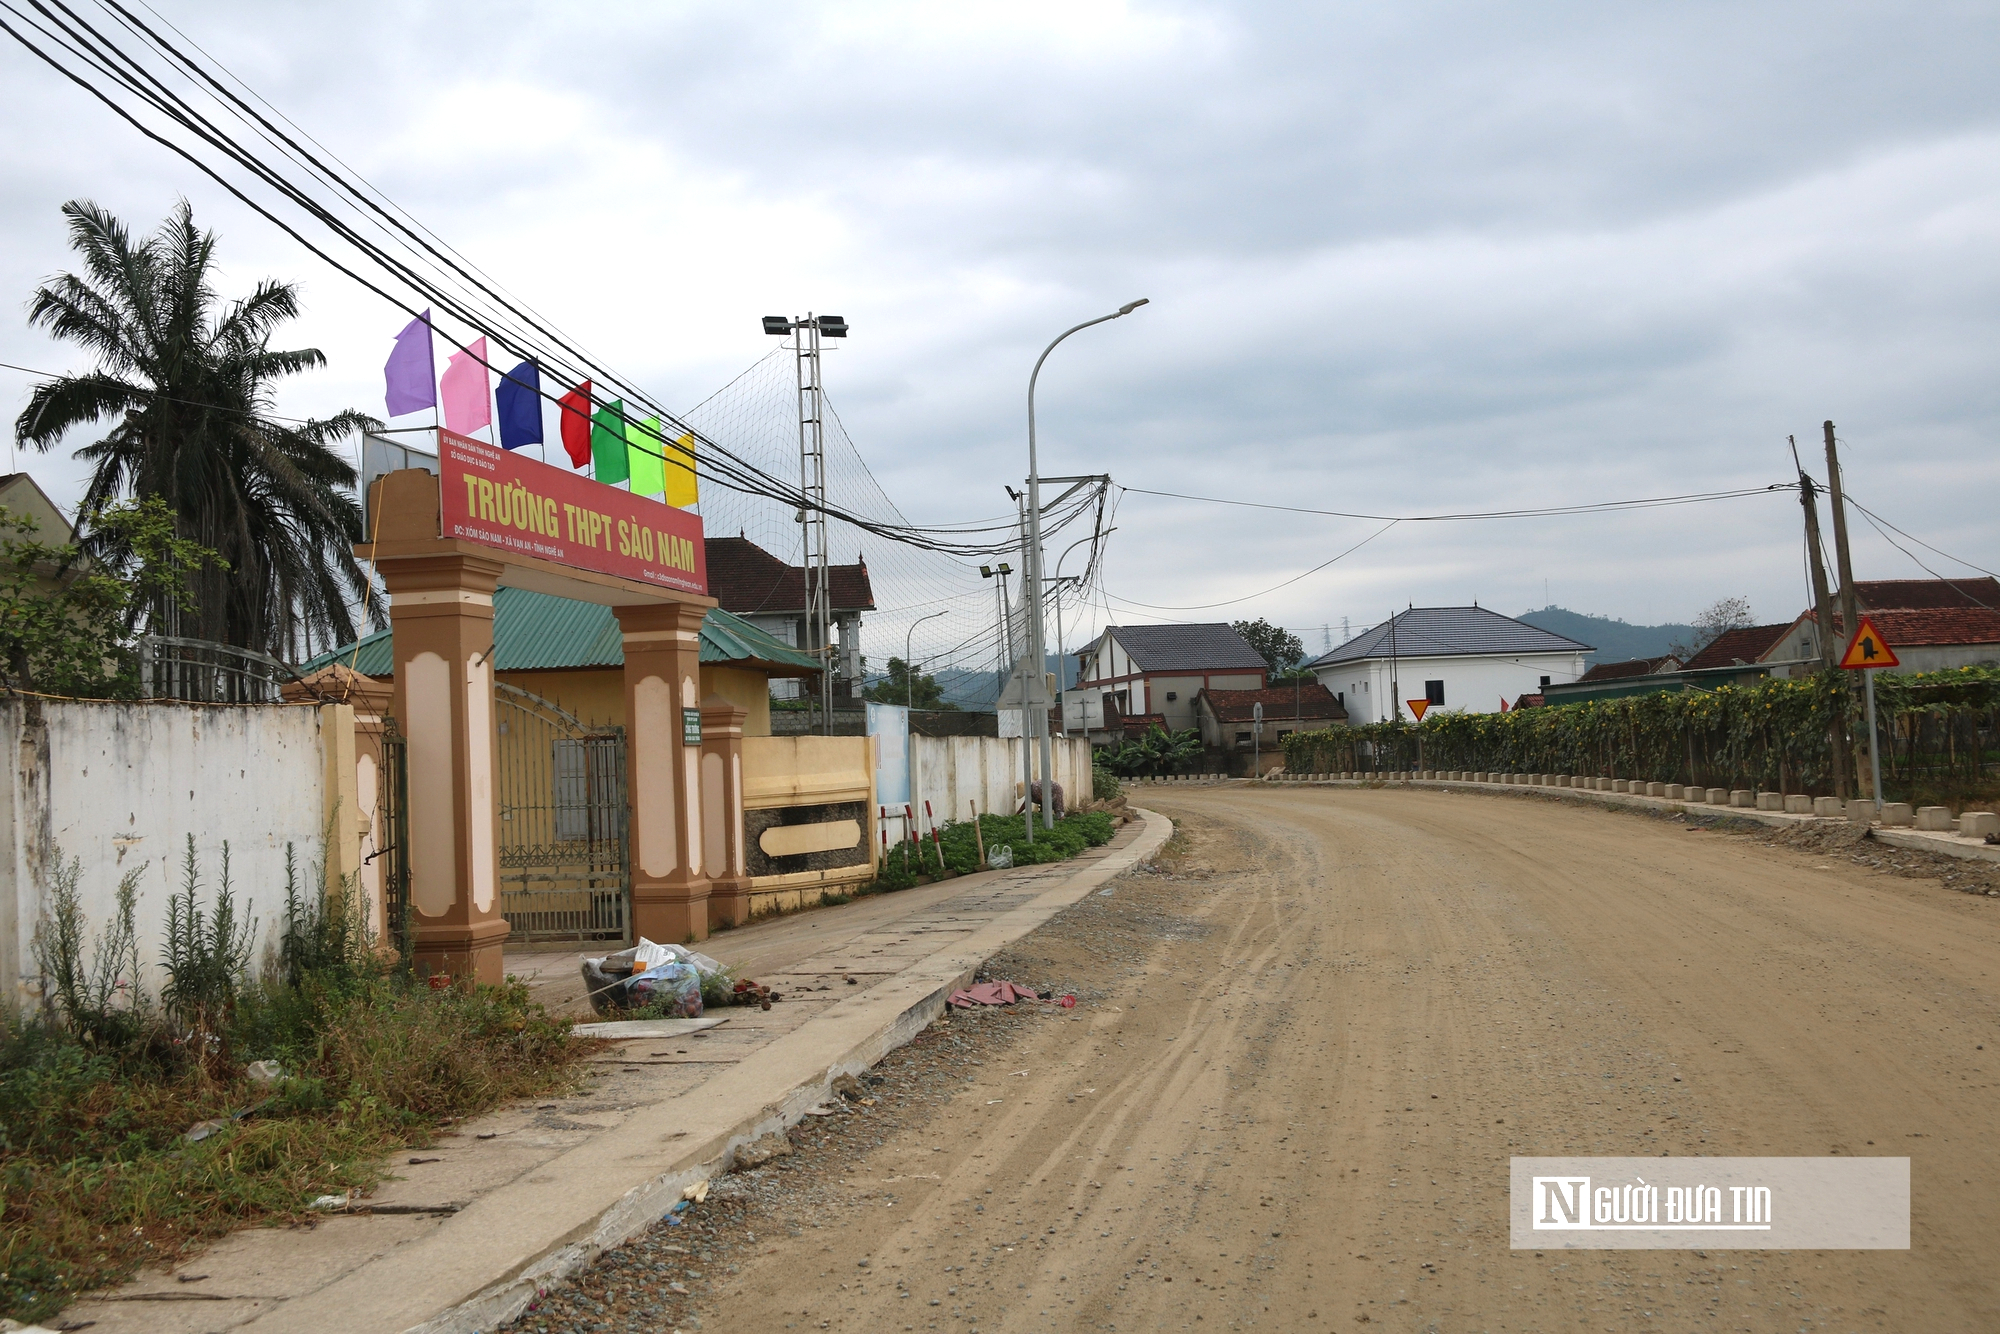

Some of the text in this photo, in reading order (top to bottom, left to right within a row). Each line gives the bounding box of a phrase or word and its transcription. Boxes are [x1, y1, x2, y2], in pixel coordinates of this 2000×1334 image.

[449, 437, 457, 446] BAN
[495, 453, 501, 461] AN
[463, 473, 695, 574] TRƯỜNG THPT SÀO NAM
[454, 524, 465, 536] ĐC:
[465, 525, 478, 539] XÓM
[479, 528, 490, 541] SÀO
[490, 532, 502, 544] NAM
[513, 537, 524, 550] VẠN
[524, 540, 531, 550] AN
[557, 548, 564, 558] AN
